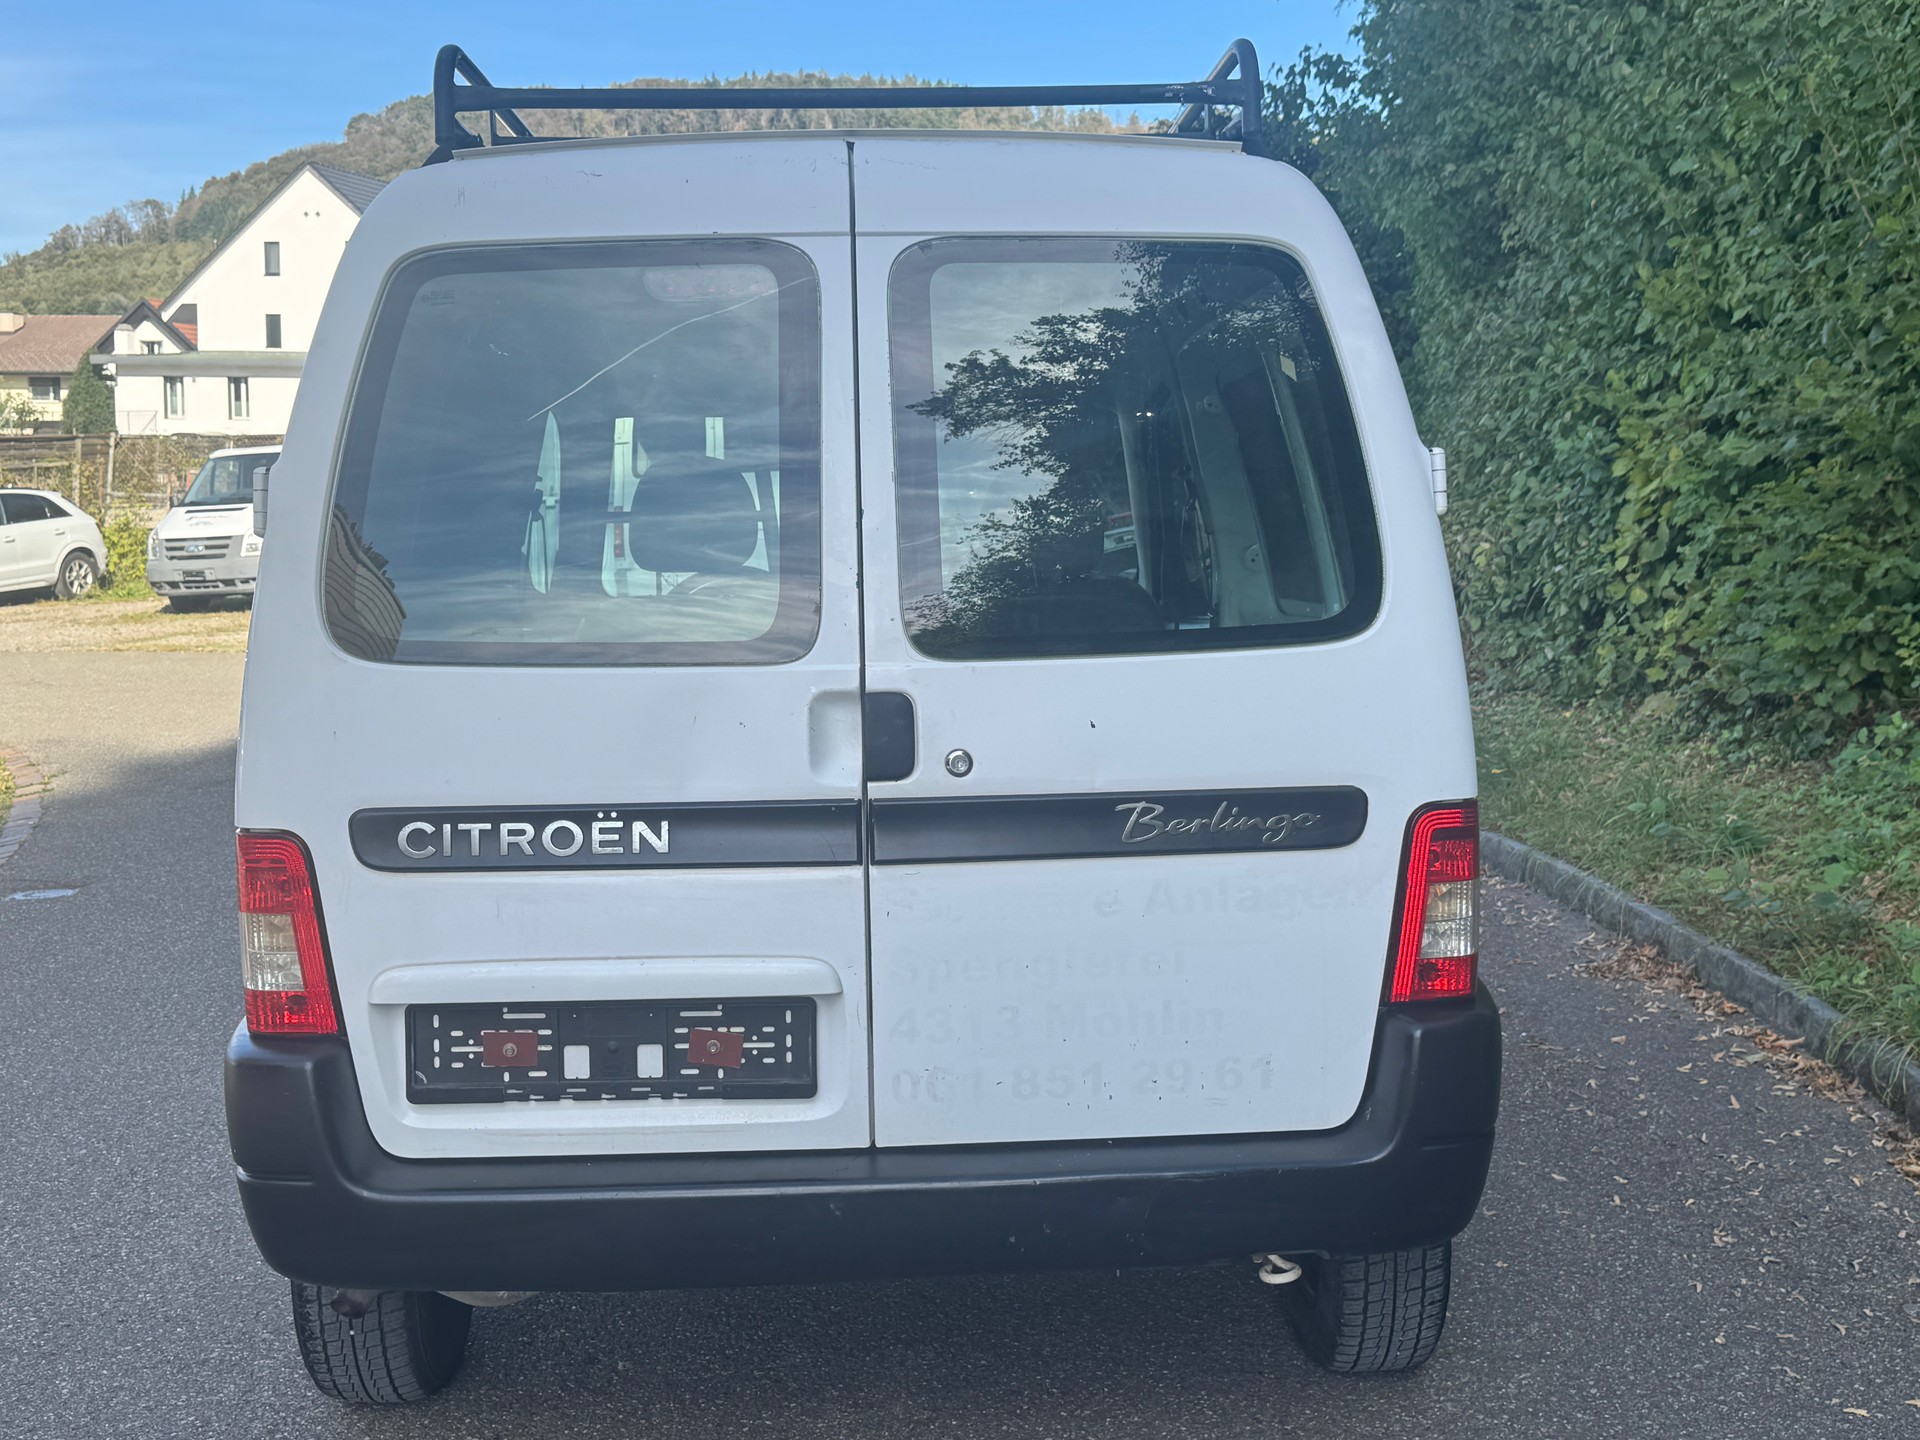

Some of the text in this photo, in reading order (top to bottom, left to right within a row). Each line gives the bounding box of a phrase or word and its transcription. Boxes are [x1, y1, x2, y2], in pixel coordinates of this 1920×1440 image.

[397, 811, 669, 859] CITROËN
[1114, 800, 1321, 844] Berlingo
[888, 939, 1185, 994] Spenglerei
[888, 1004, 1021, 1046] 4313
[1046, 999, 1226, 1040] Möhlin
[1010, 1061, 1103, 1101] 851
[1130, 1058, 1193, 1096] 29
[1214, 1054, 1274, 1093] 61
